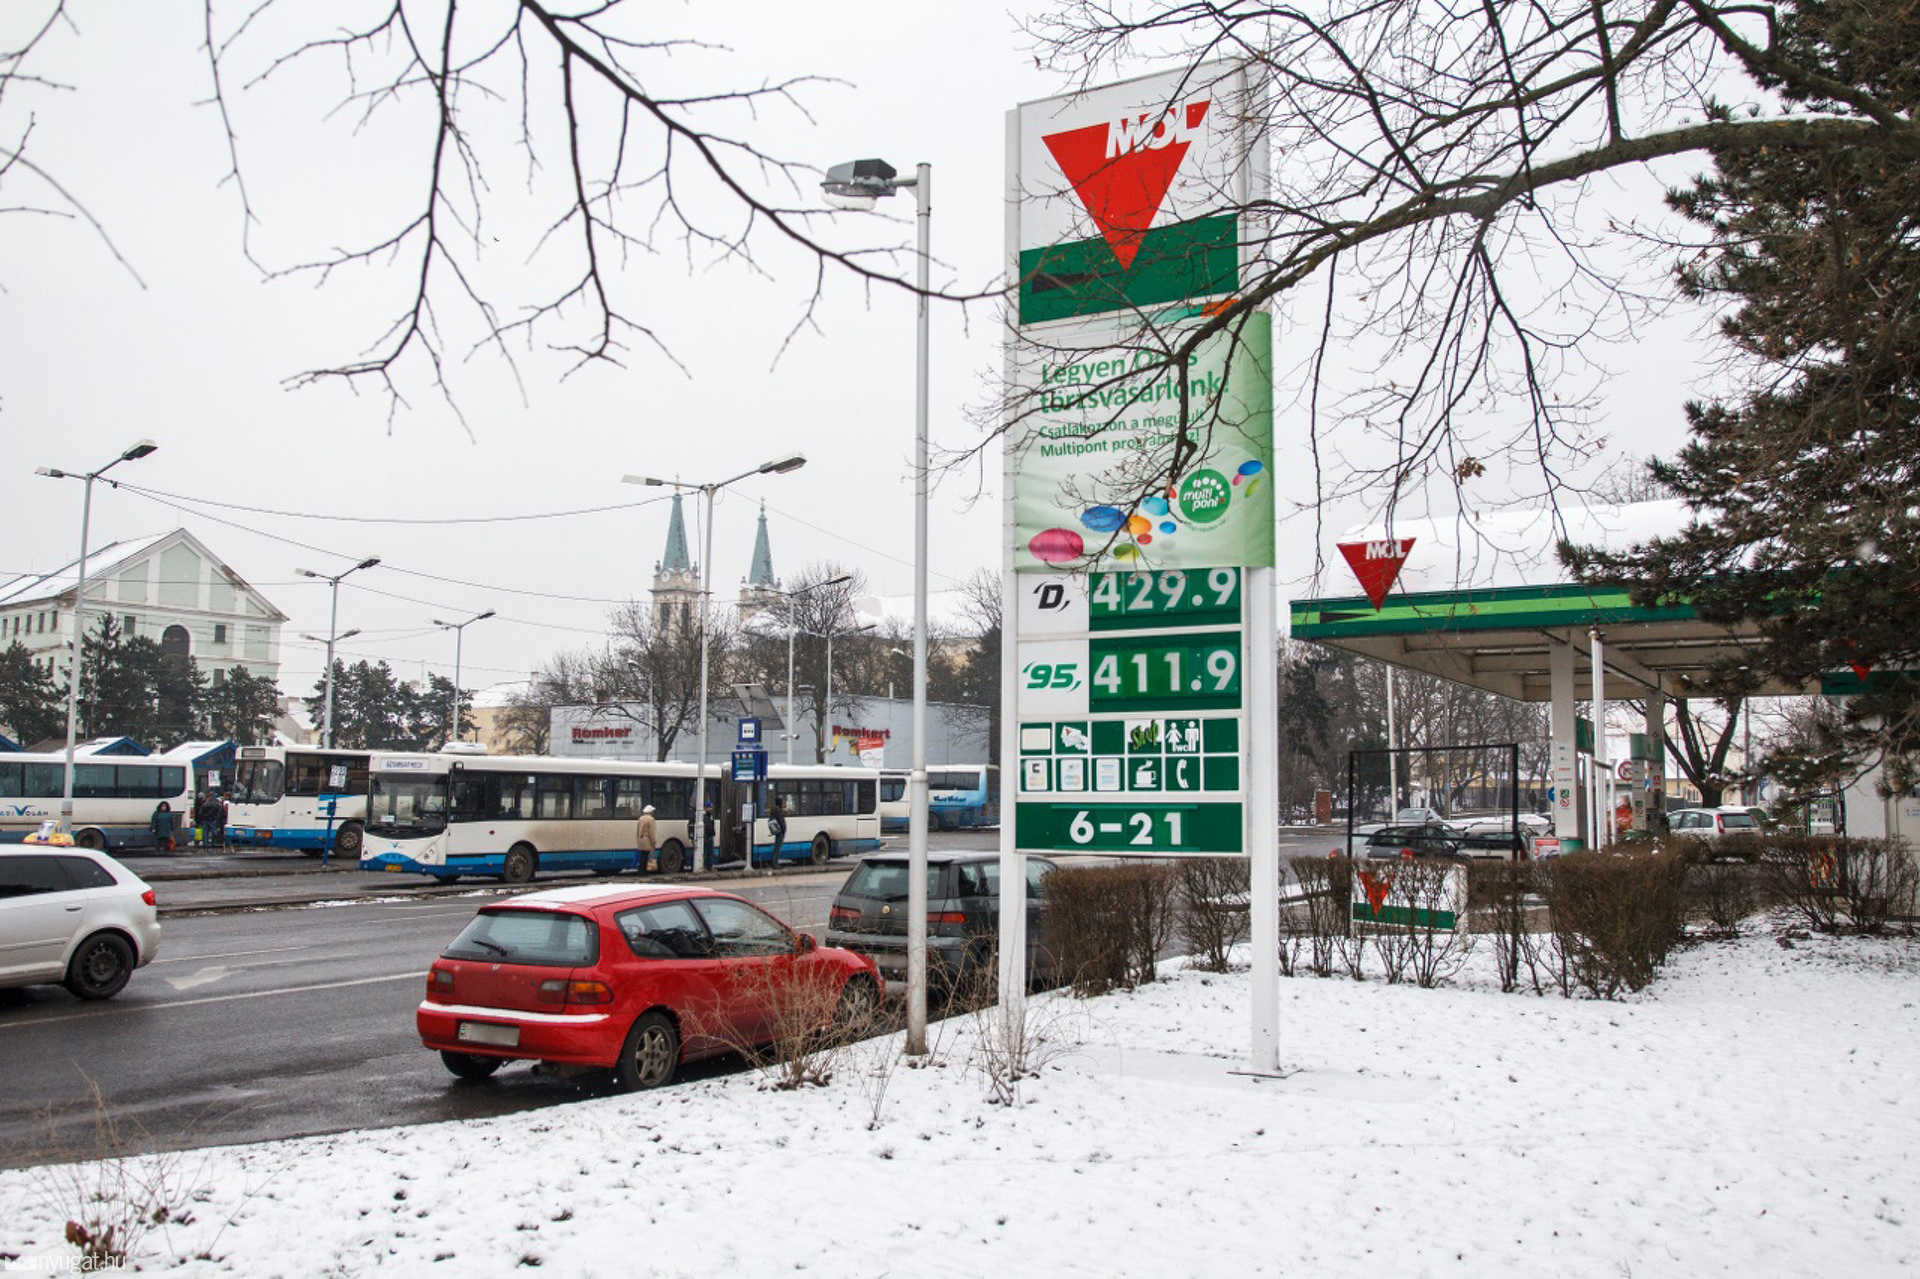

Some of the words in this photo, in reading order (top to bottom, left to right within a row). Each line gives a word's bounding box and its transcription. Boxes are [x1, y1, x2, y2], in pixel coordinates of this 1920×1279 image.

[1105, 104, 1201, 159] MOL
[1042, 359, 1126, 386] Legyen
[1040, 420, 1126, 439] Csatlakozon
[1131, 419, 1139, 428] a
[1040, 440, 1108, 457] Multipont
[1183, 488, 1212, 501] multi
[1192, 496, 1219, 512] pont
[1365, 540, 1407, 560] MOL
[1092, 568, 1237, 612] 429.9
[1093, 650, 1236, 694] 411.9
[1069, 811, 1182, 846] 6-21
